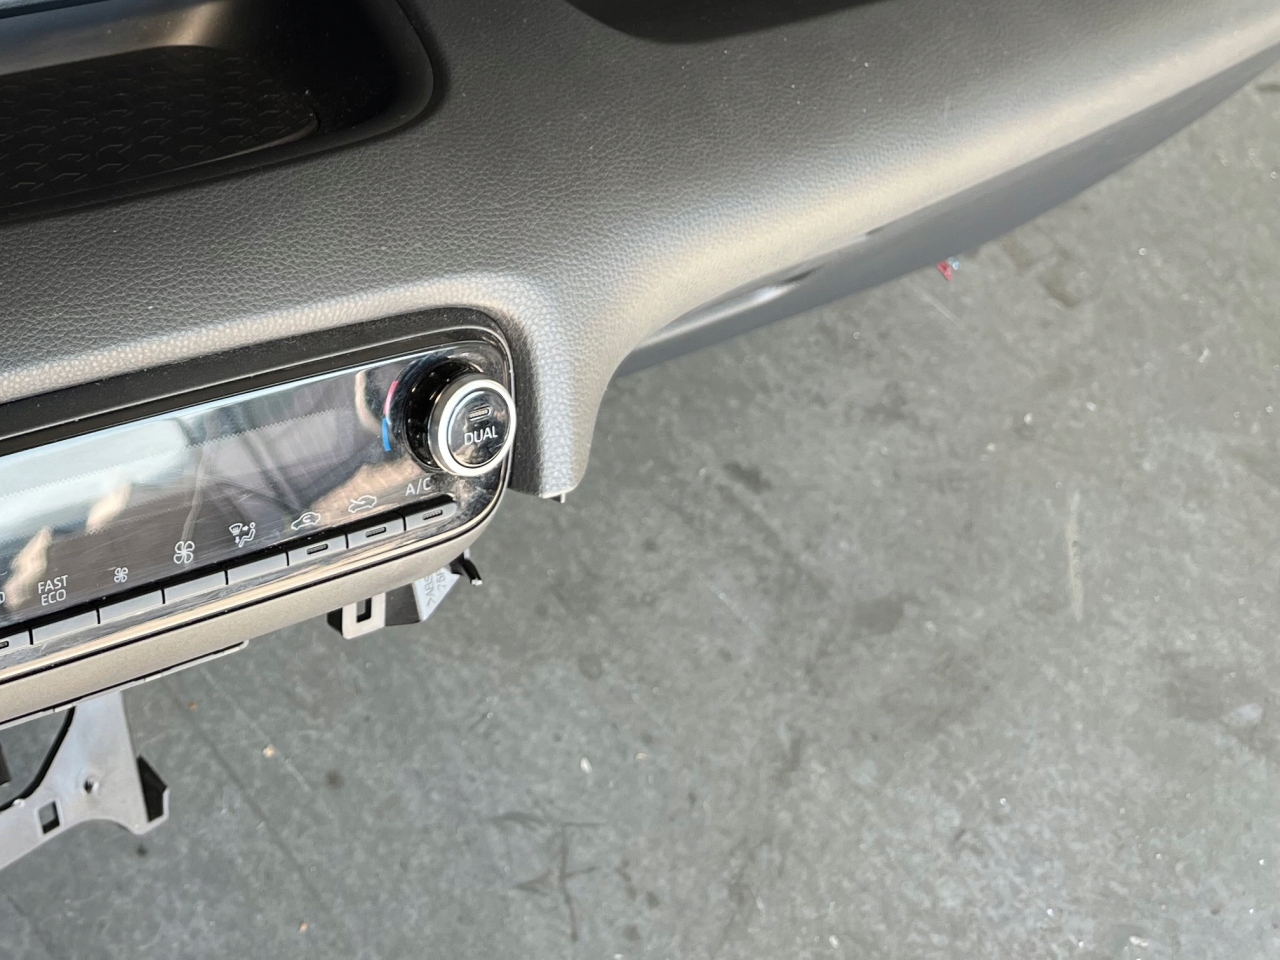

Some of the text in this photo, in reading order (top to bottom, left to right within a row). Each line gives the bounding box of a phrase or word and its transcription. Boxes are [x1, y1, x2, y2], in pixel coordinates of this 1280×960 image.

[464, 425, 499, 446] DUAL
[405, 477, 432, 497] A/C
[37, 574, 69, 594] FAST
[41, 589, 67, 606] ECO
